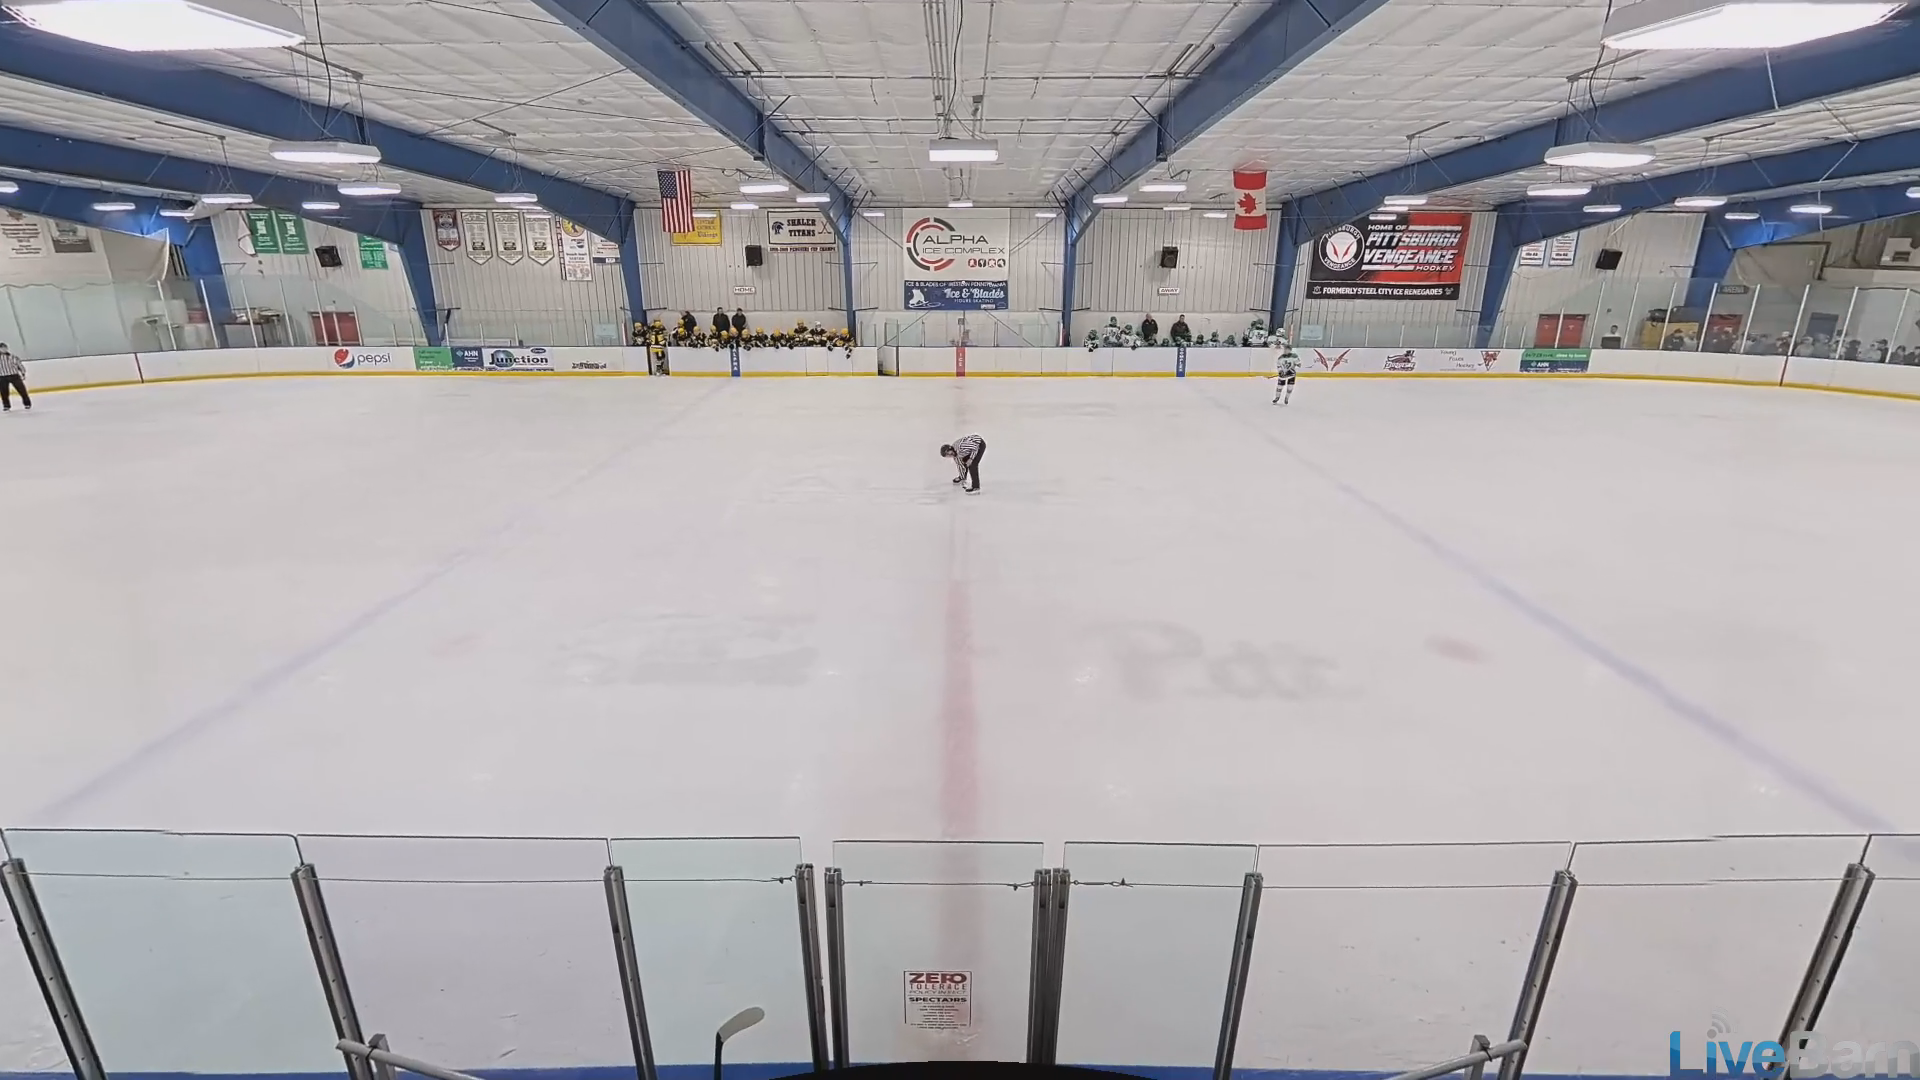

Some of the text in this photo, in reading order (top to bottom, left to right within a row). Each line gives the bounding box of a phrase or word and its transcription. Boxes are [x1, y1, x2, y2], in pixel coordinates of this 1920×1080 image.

[787, 218, 817, 226] SHALER
[923, 235, 989, 244] ALPHA
[1365, 232, 1462, 247] PITTSBURGH
[1324, 256, 1357, 270] VENGEANCE
[1363, 249, 1458, 265] VENGEANCE
[943, 288, 1005, 299] Ice & Blades
[1357, 287, 1377, 295] STEEL
[1377, 287, 1393, 295] CITY
[356, 353, 392, 365] pepsi
[489, 353, 548, 365] Junction
